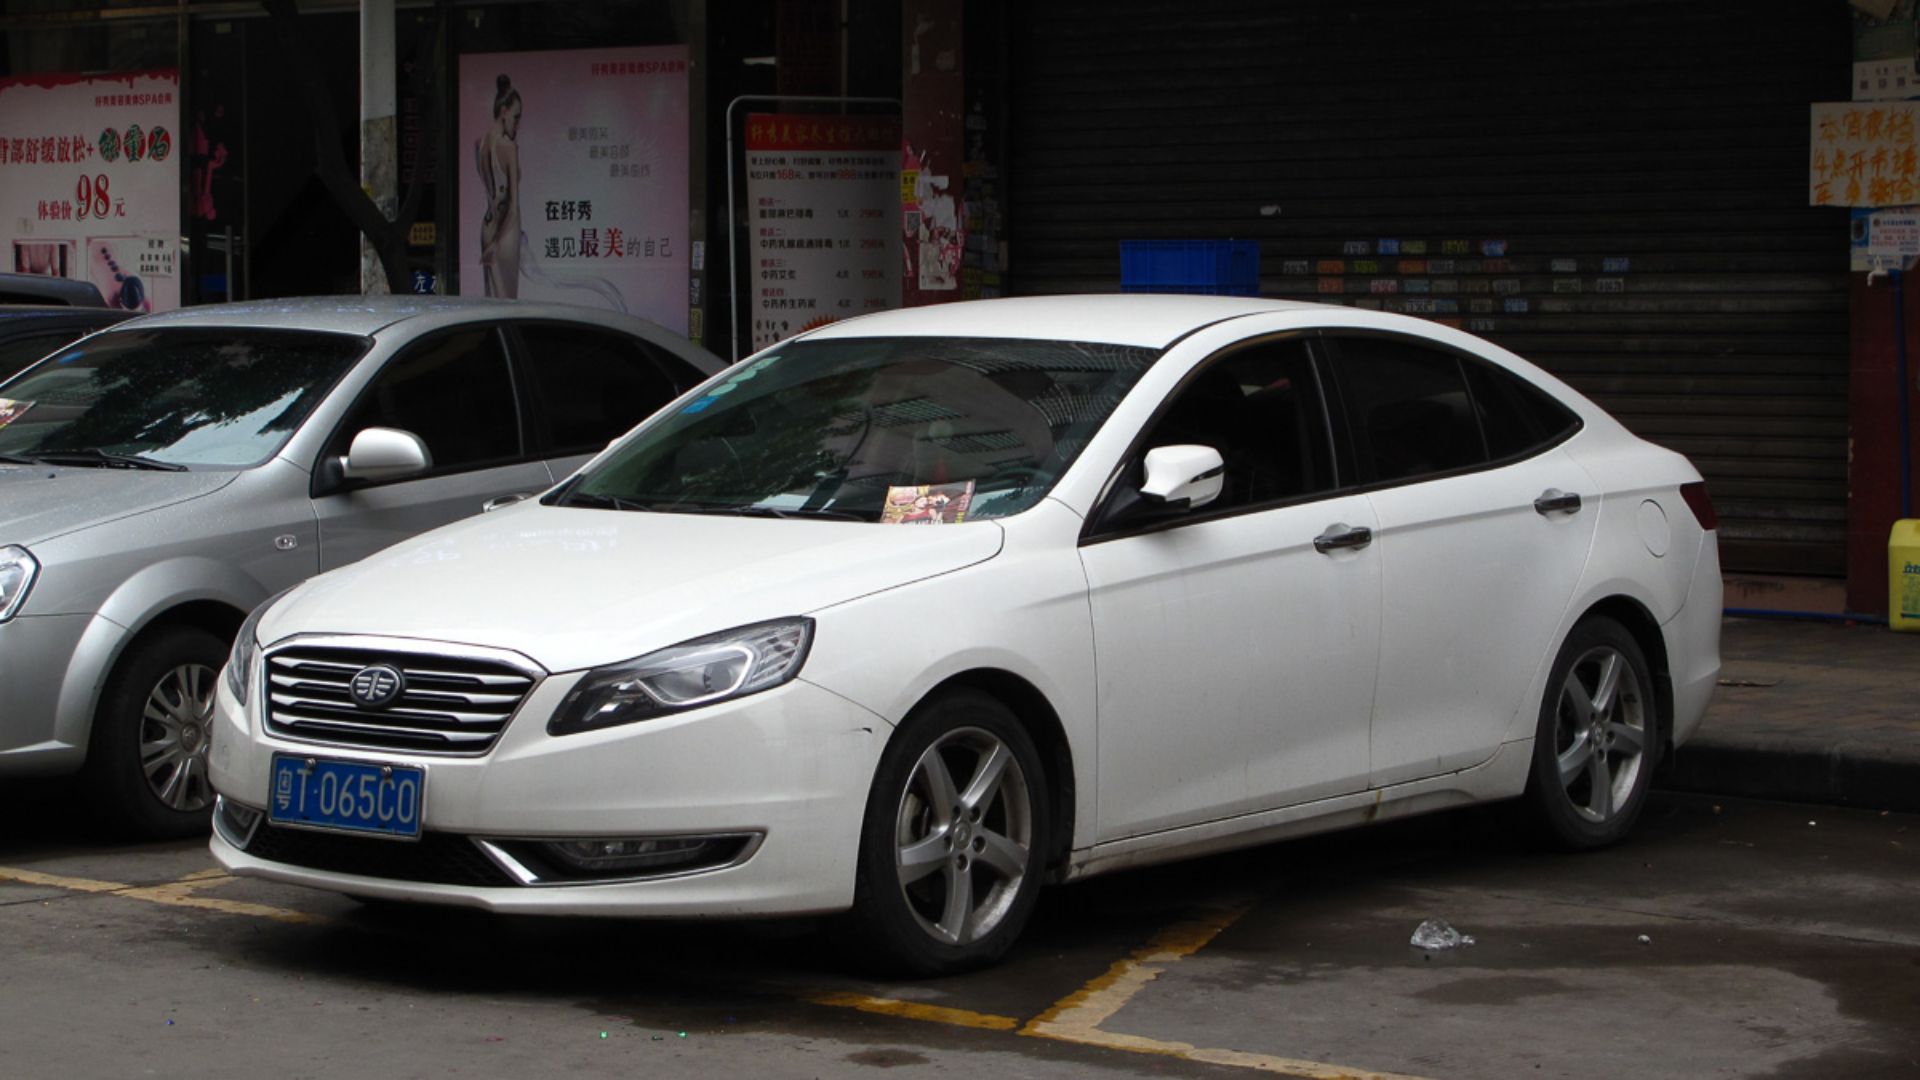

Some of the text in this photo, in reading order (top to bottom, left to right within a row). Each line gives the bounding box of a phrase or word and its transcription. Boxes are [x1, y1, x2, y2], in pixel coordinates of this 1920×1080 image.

[545, 199, 592, 222] 在纤秀
[545, 227, 673, 258] 遇见最美的自己
